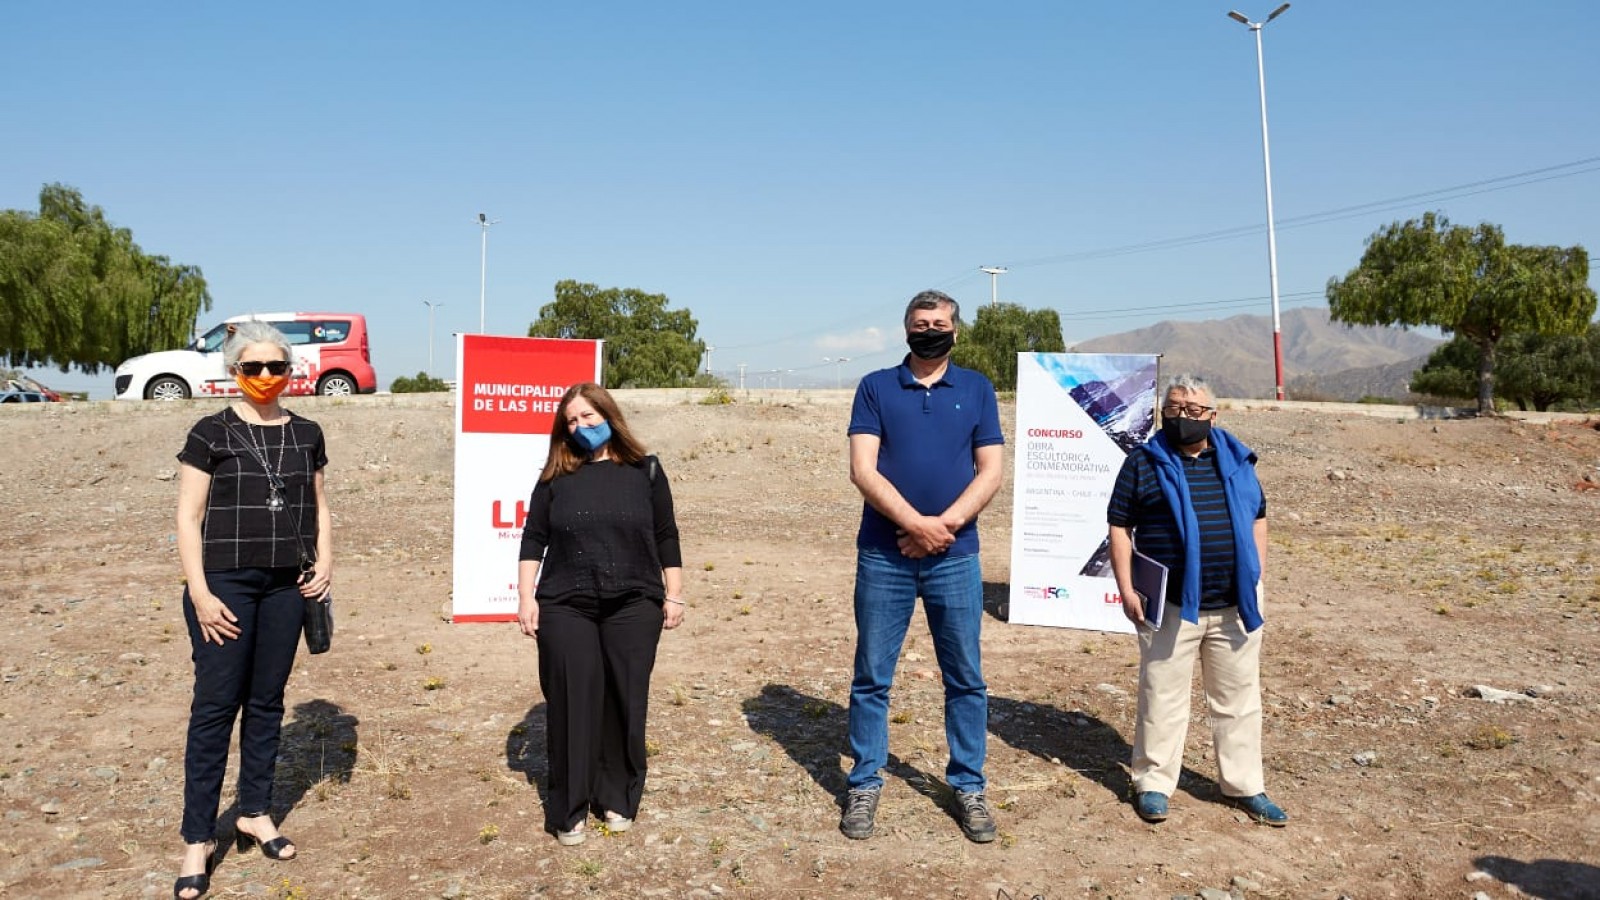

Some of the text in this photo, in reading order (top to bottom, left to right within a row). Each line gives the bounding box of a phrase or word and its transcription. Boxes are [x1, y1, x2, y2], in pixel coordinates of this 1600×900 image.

[474, 399, 494, 411] DE
[499, 400, 527, 412] LAS
[1027, 428, 1083, 439] CONCURSO
[1027, 441, 1054, 451] OBRA
[1027, 461, 1110, 473] CONMEMORATIVA
